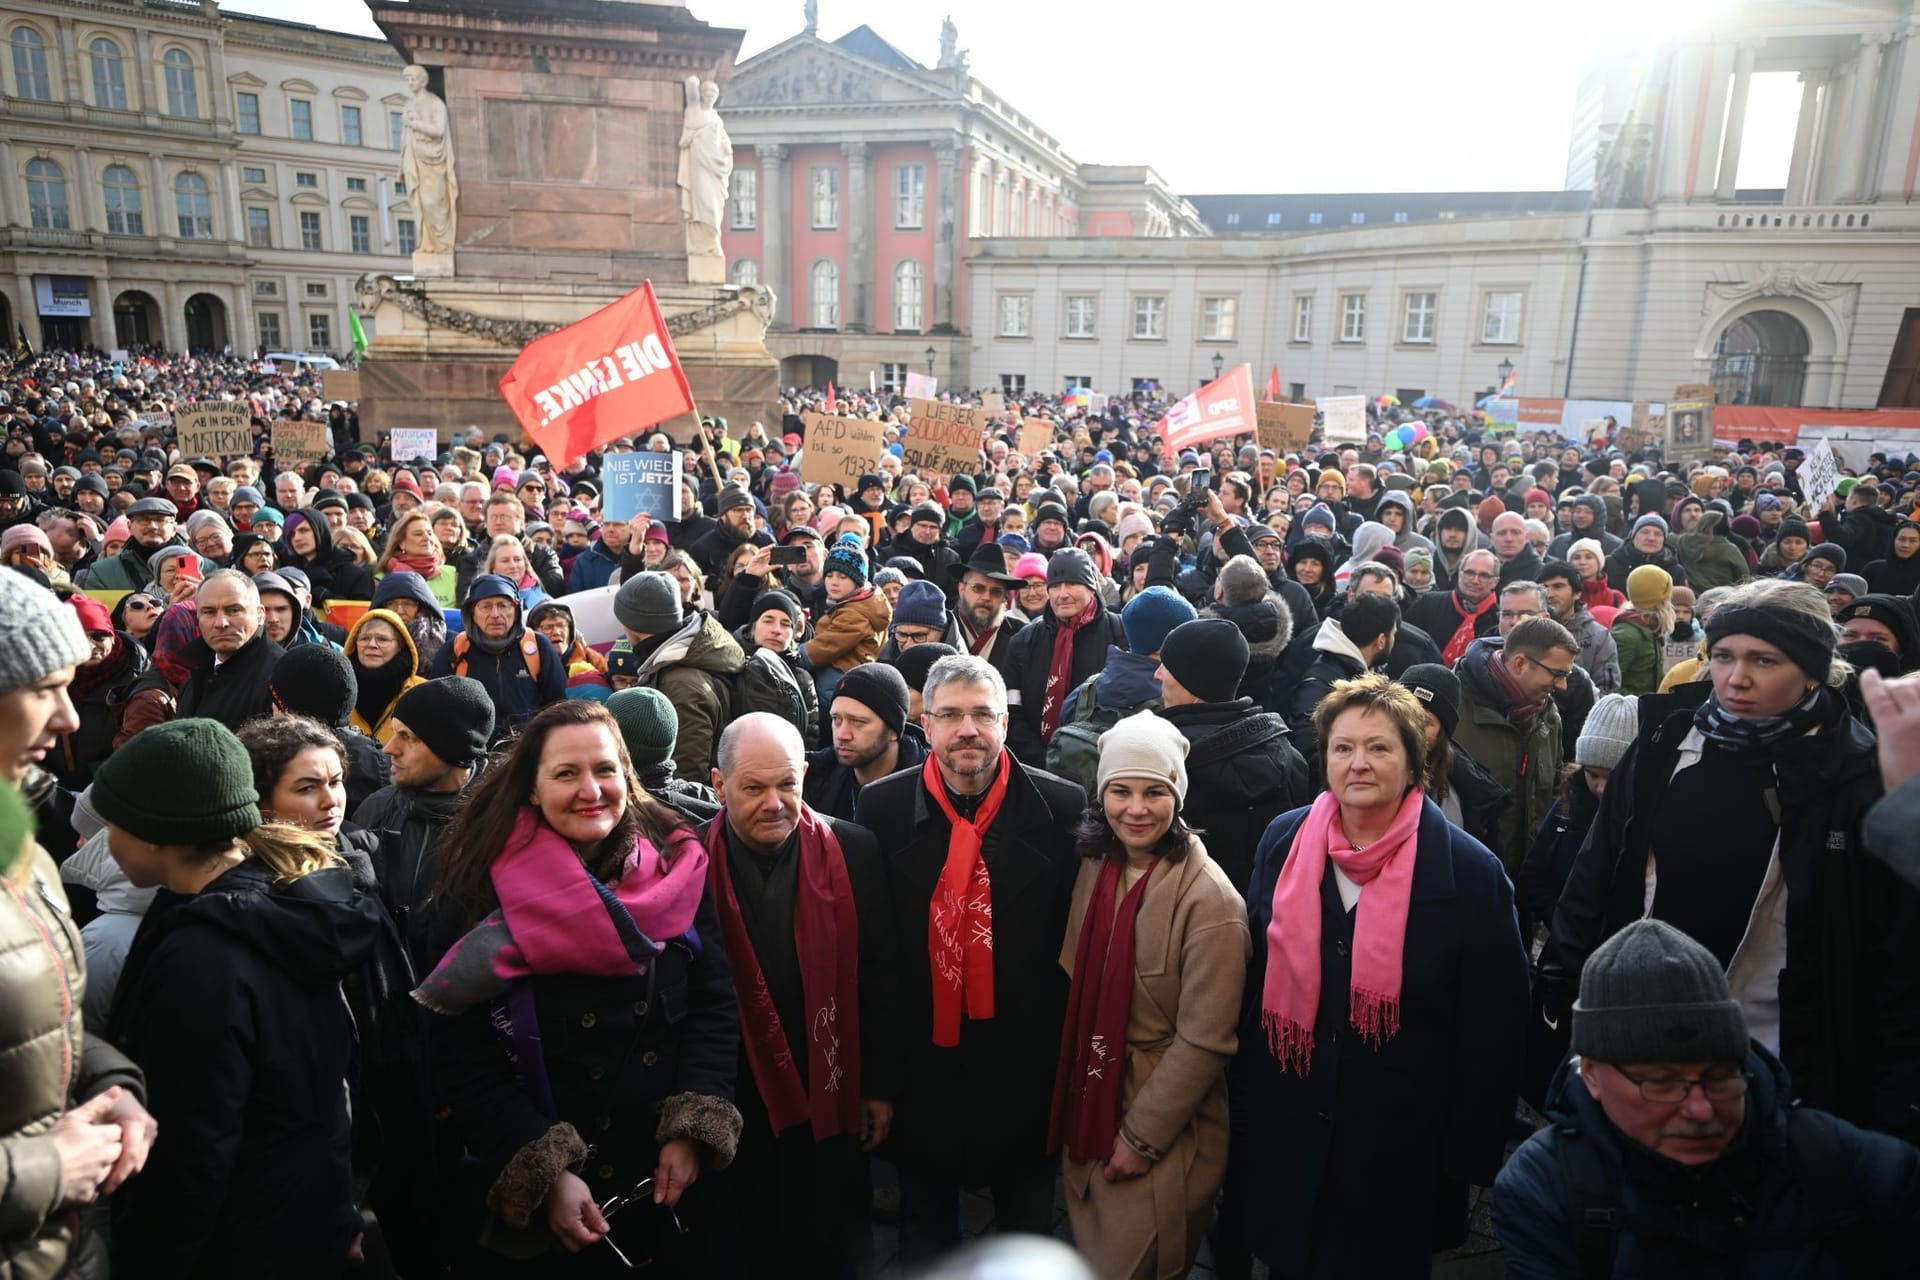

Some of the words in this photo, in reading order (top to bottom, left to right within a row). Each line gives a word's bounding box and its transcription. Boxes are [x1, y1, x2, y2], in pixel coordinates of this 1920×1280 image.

[53, 297, 82, 306] Munch
[926, 403, 975, 426] LIEBER
[192, 417, 207, 428] AB
[210, 415, 219, 427] IN
[222, 416, 243, 426] DEN
[813, 419, 847, 440] AfD
[908, 416, 981, 449] SOLIDARISCH
[831, 445, 843, 454] so
[931, 443, 949, 456] ALS
[607, 460, 631, 473] NIE
[615, 473, 636, 485] IST
